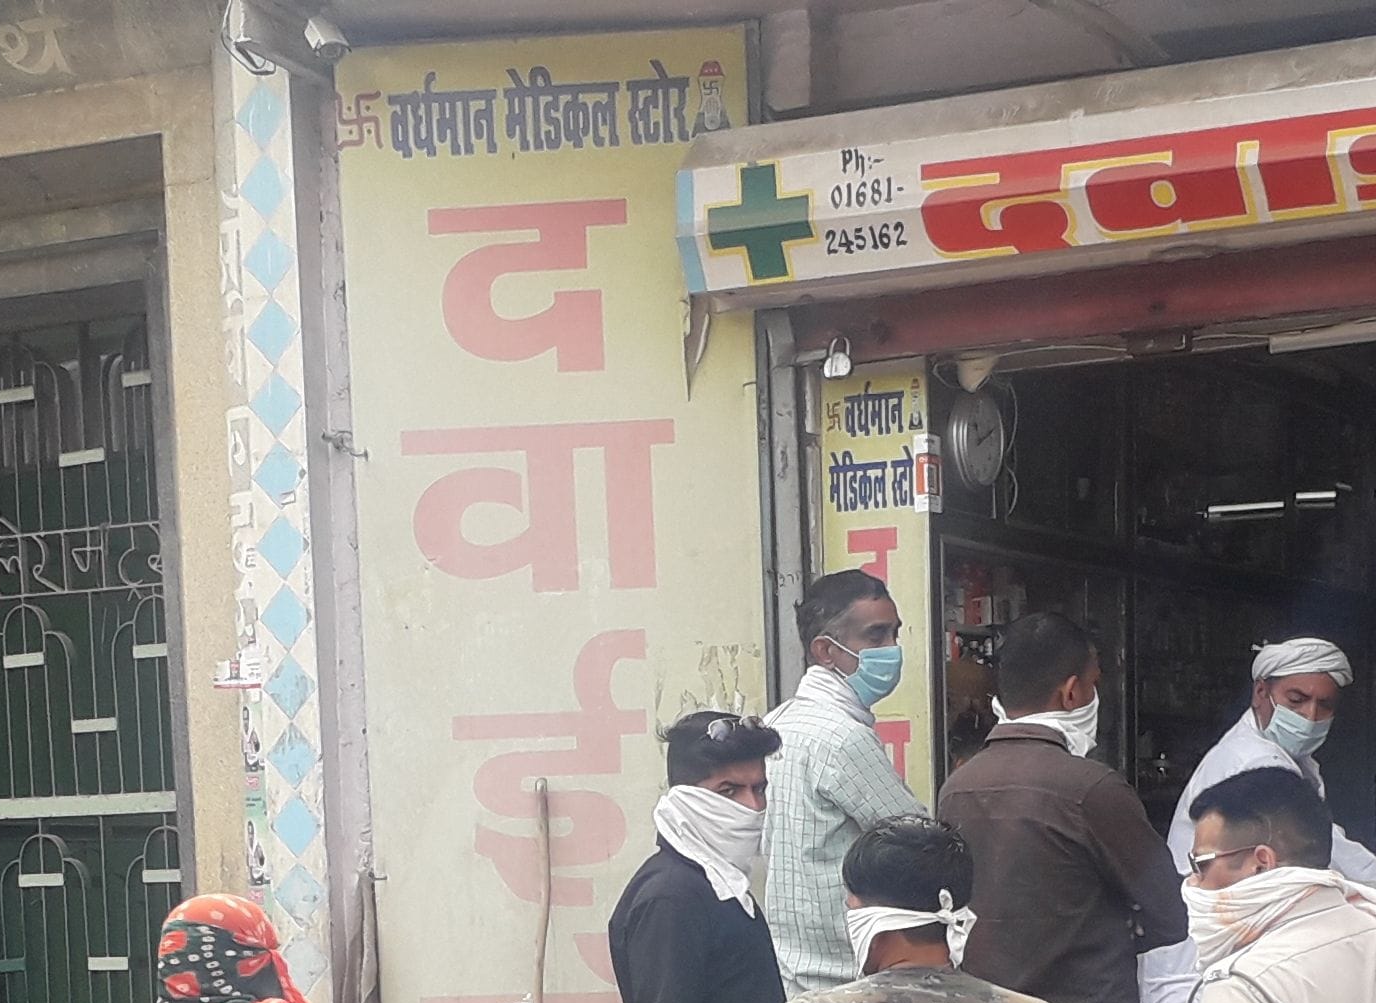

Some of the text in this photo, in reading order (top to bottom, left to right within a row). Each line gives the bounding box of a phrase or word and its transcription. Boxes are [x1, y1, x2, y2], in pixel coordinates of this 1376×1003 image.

[388, 70, 497, 160] वर्धमान
[504, 65, 620, 153] मेडिकल
[830, 179, 904, 210] 01681-
[825, 221, 908, 255] 245162
[843, 380, 905, 438] वर्धमान
[828, 451, 888, 513] मेडिकल
[890, 445, 917, 508] स्टो
